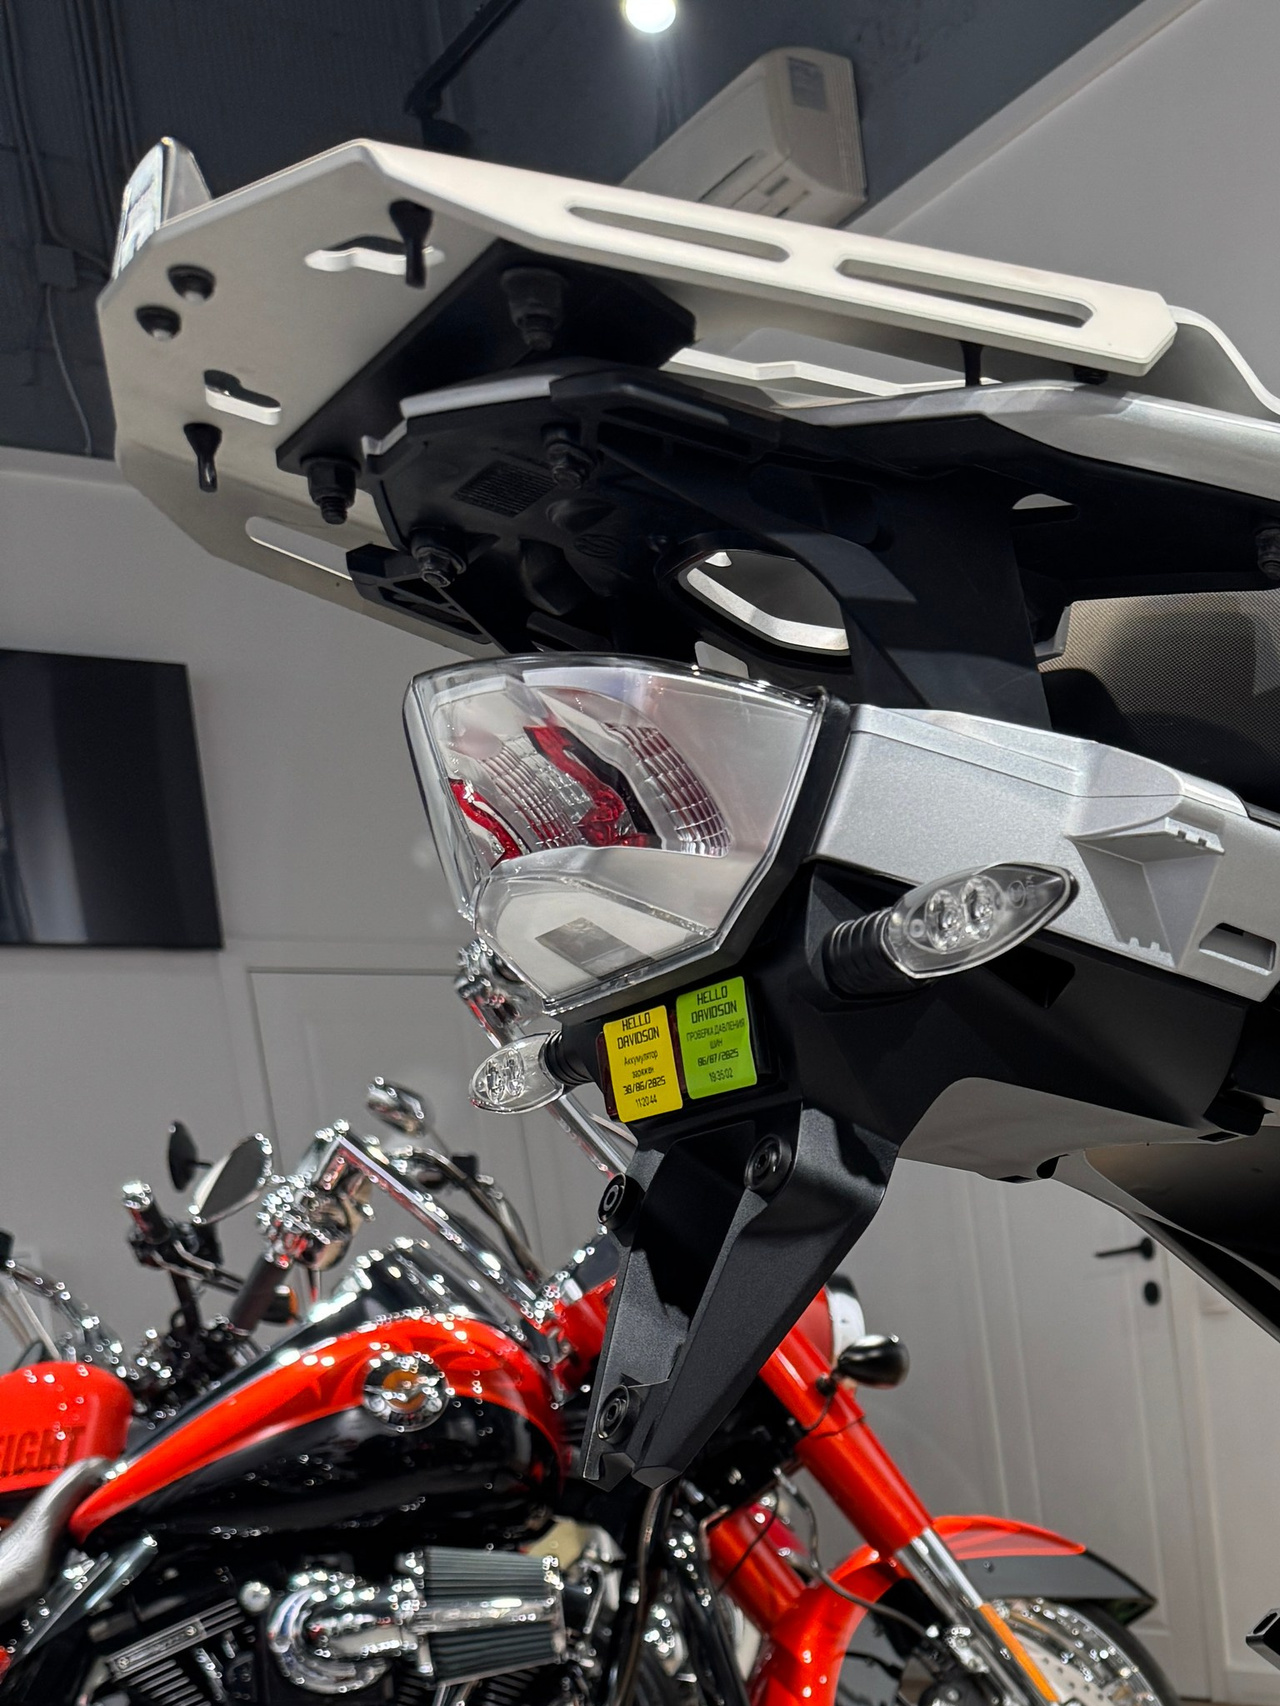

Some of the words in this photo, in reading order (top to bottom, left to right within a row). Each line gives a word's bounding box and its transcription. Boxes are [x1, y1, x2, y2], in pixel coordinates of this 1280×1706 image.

[697, 985, 728, 1006] HELLO
[621, 1012, 651, 1032] HELLO
[691, 1000, 738, 1024] DAVIDSON
[617, 1026, 660, 1050] DAVIDSON
[0, 1424, 87, 1479] IGHT
